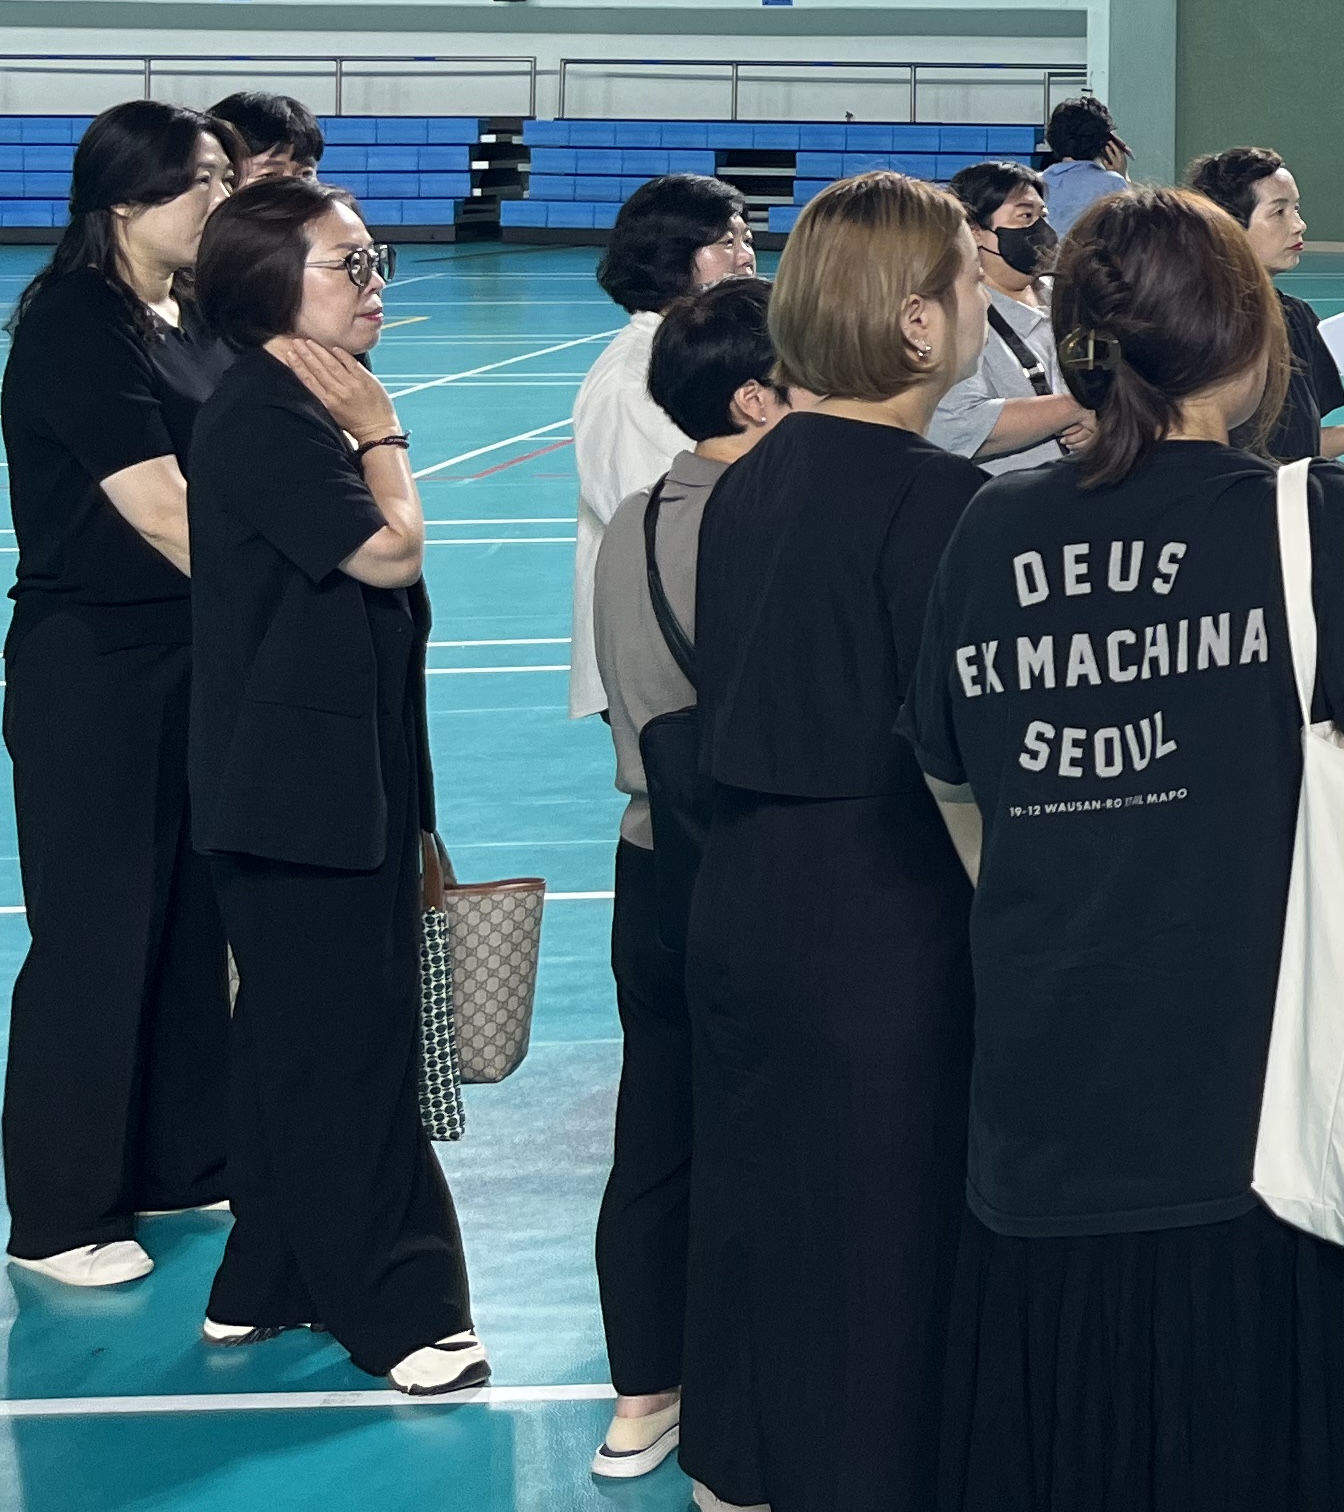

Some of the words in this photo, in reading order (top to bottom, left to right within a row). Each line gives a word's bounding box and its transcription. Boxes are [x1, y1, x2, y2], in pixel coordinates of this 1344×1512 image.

[1013, 540, 1187, 608] DEUS
[956, 640, 1005, 698] EX
[1016, 607, 1268, 690] MACHINA
[1018, 711, 1178, 778] SEOUL
[1010, 805, 1041, 817] 19-12
[1044, 798, 1122, 814] WAUSAN-RO
[1146, 788, 1188, 804] MAPO
